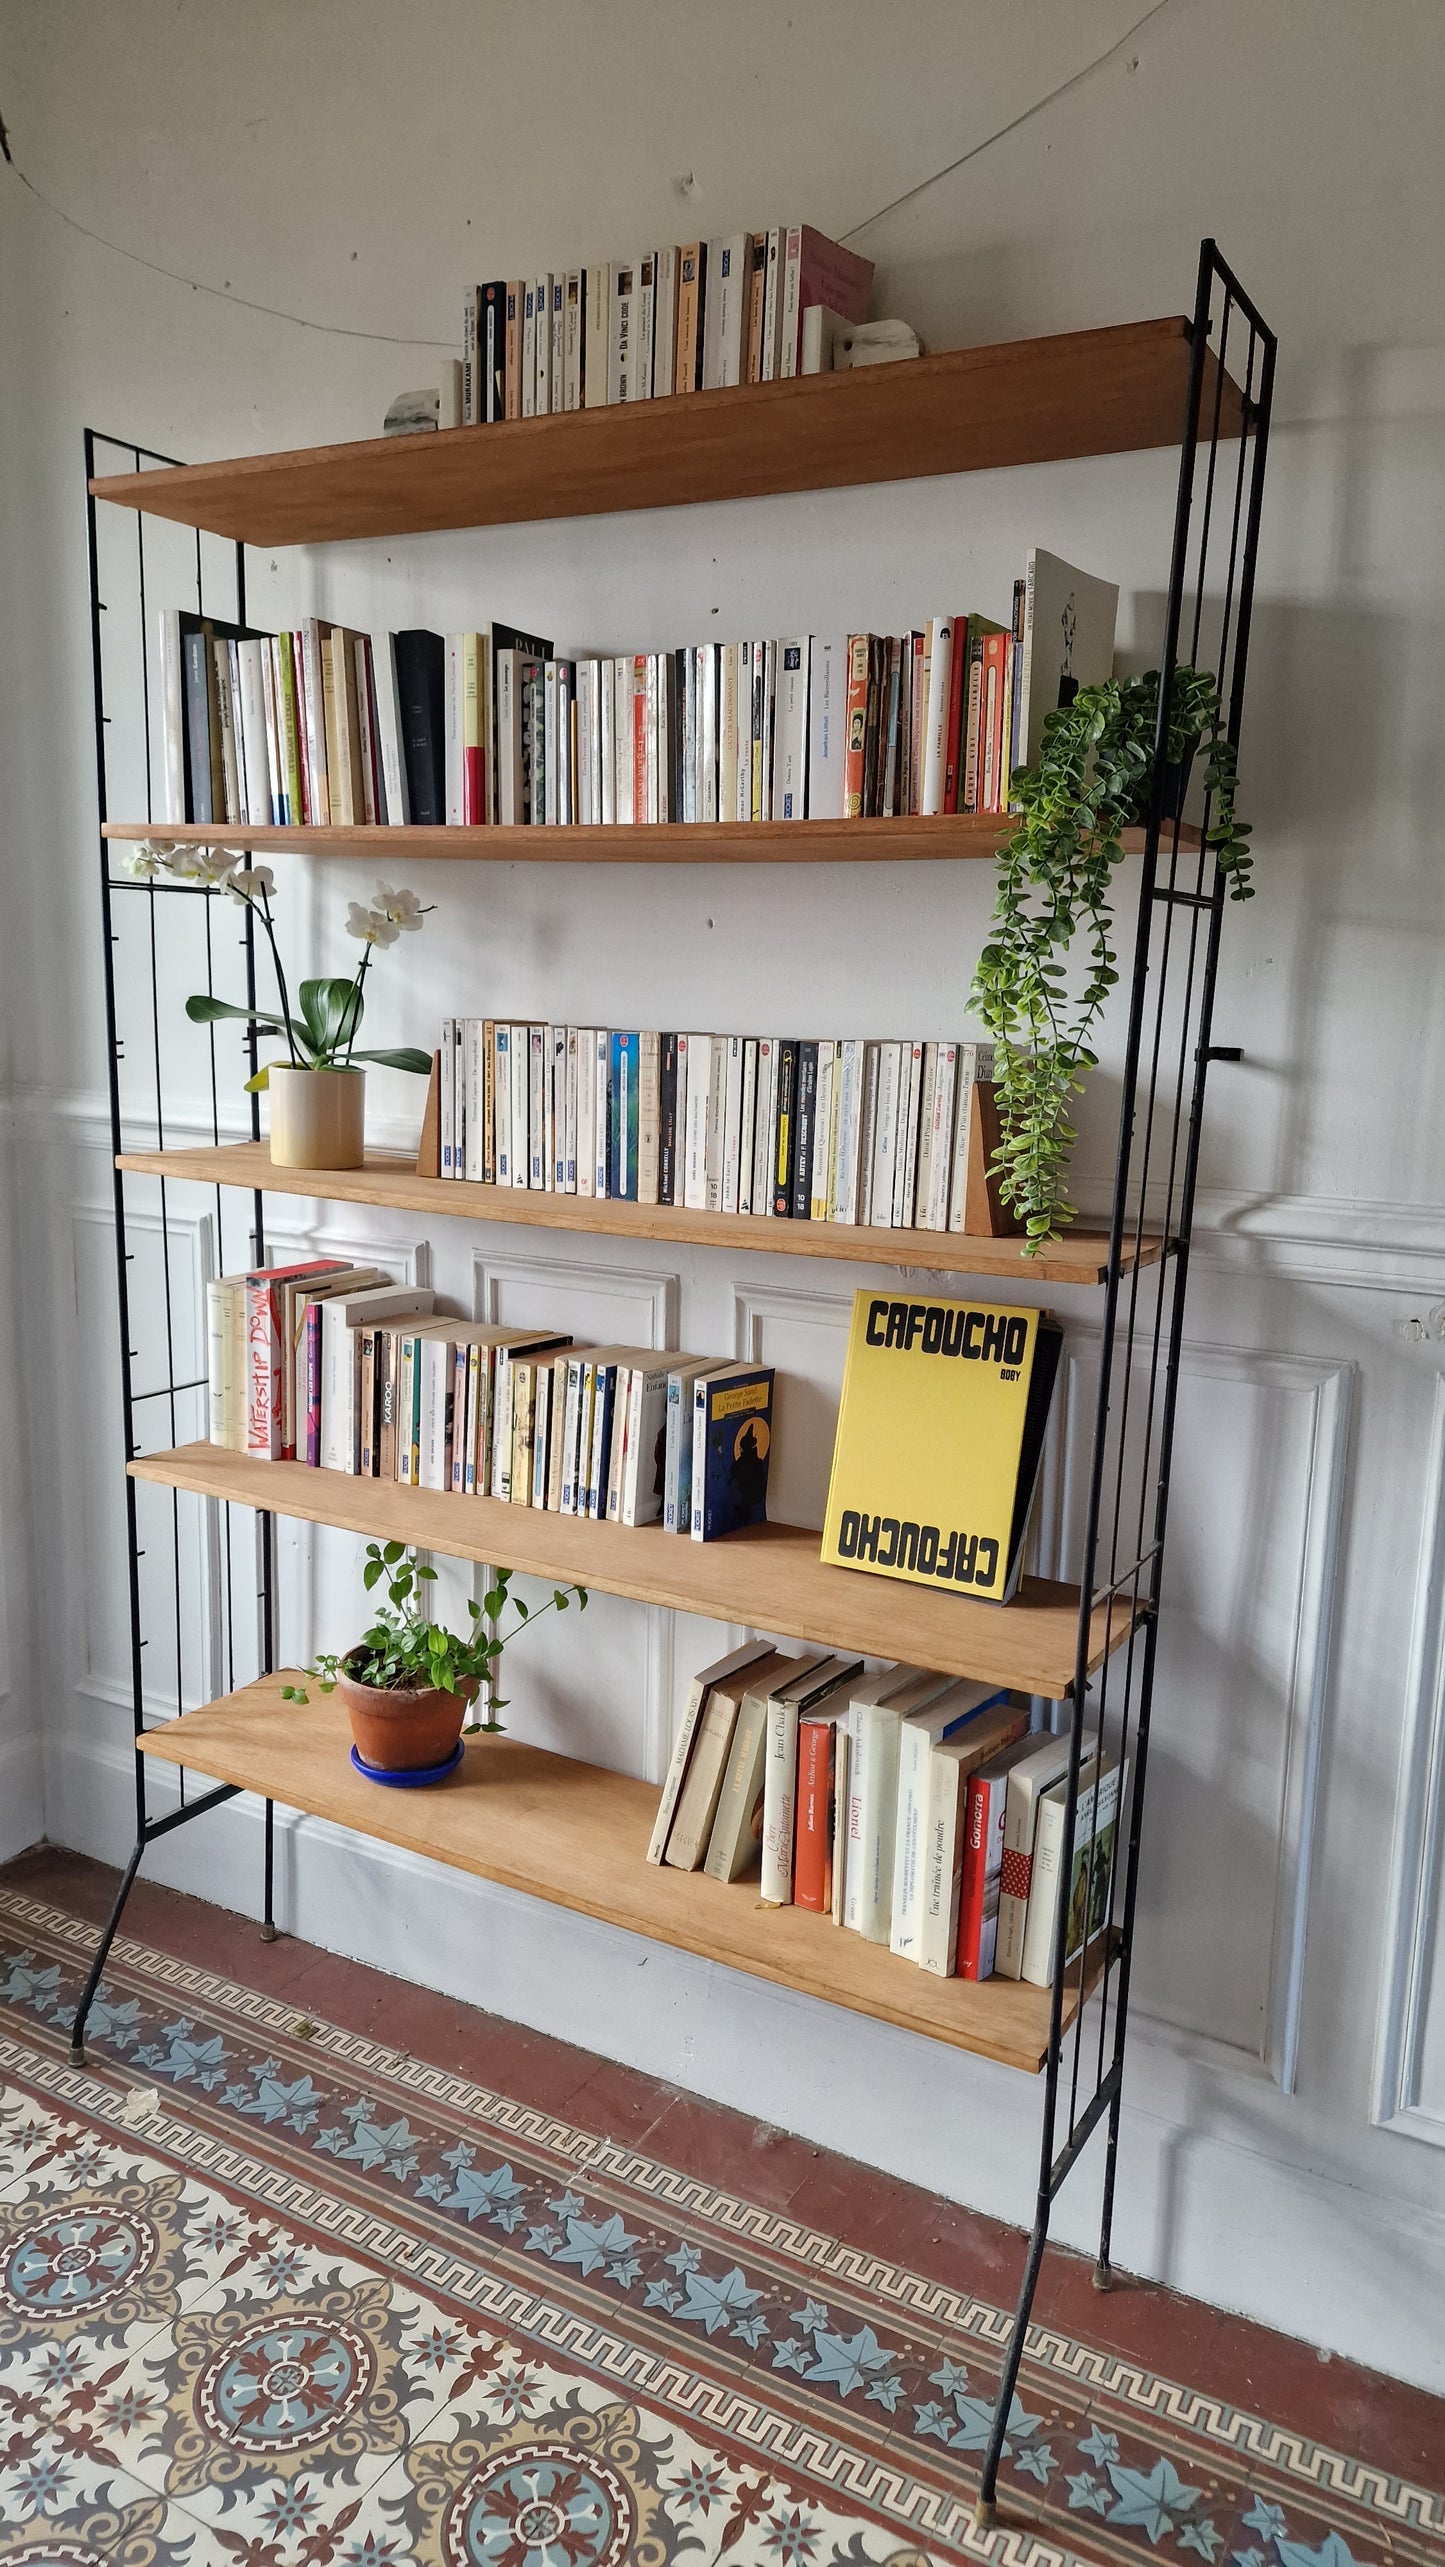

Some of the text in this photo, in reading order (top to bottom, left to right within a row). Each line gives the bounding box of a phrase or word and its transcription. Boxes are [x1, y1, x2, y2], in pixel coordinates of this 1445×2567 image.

[619, 302, 629, 350] DA VINCI CODE
[619, 374, 627, 397] BROWN
[1027, 562, 1035, 589] FABCARO
[971, 666, 979, 711] ISABELLE
[866, 1300, 1028, 1366] CAFOUCHO
[246, 1286, 270, 1449] WATERSHIP DOWN
[1000, 1369, 1021, 1382] BOBY
[646, 1382, 668, 1392] Enfanc
[725, 1386, 758, 1401] George Sand
[384, 1381, 392, 1424] KAROO
[718, 1396, 762, 1413] La Petite Fadette
[838, 1510, 1000, 1588] CAFOUCHO
[675, 1694, 699, 1766] MADAME LOUIS XIV
[854, 1711, 864, 1734] Claude
[774, 1739, 786, 1762] Jean
[809, 1728, 819, 1756] George
[808, 1762, 816, 1788] Arthur
[850, 1796, 862, 1841] Lionel
[969, 1793, 984, 1850] Gomorra
[902, 1856, 910, 1887] ROOSEVELT
[929, 1820, 946, 1916] Une traînée de poudre
[849, 1897, 858, 1921] Grasset
